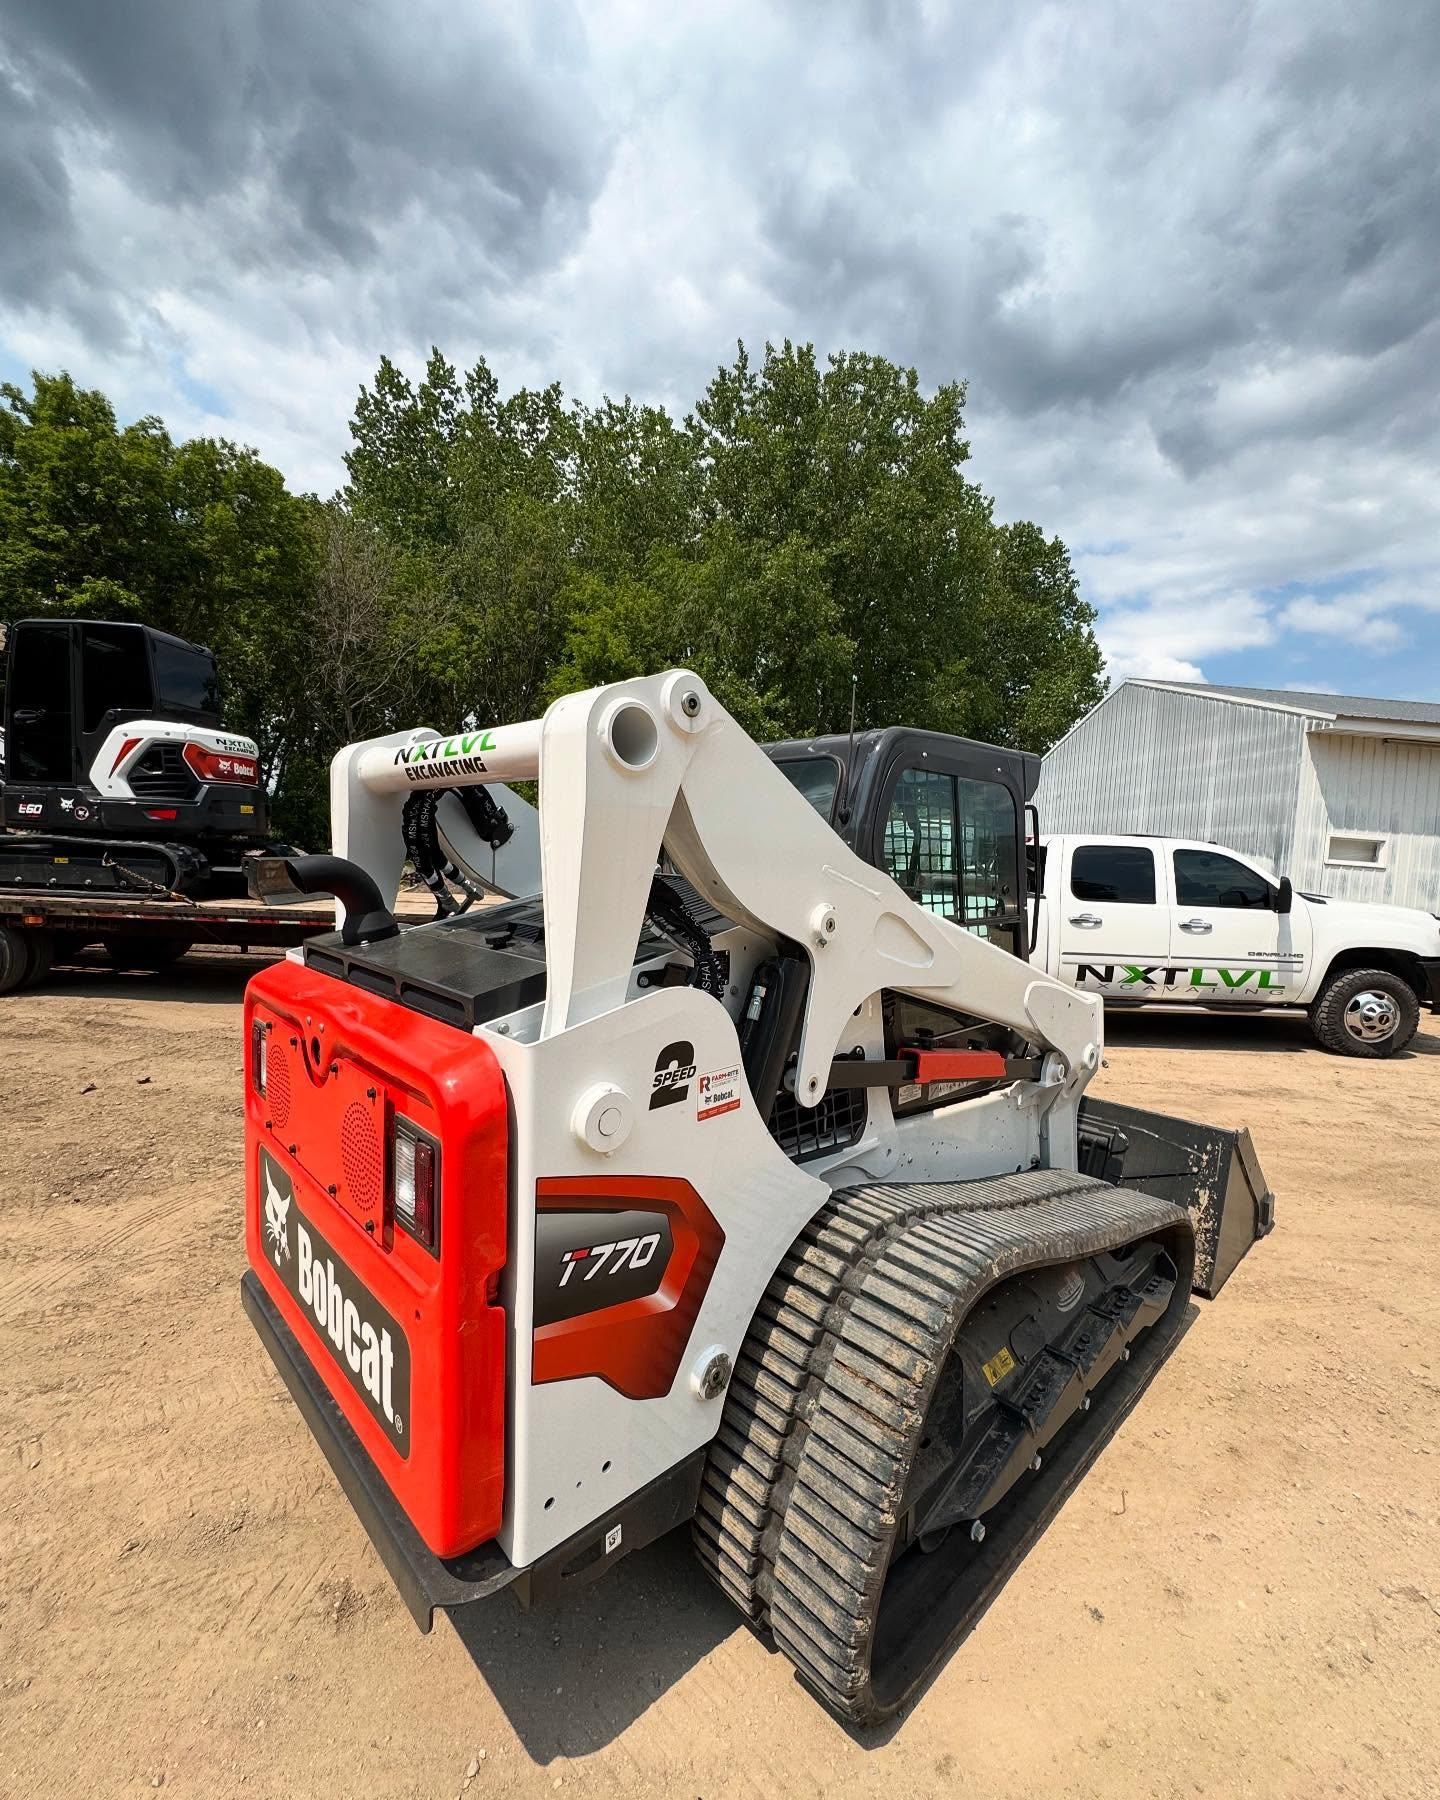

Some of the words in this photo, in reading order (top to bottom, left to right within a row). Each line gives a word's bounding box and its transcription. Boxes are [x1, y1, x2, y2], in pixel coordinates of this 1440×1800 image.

[215, 738, 256, 751] NXTLVL
[393, 732, 497, 765] NXTLVL
[404, 756, 488, 781] EXCAVATING
[1074, 981, 1285, 996] EXCAVATING
[1075, 964, 1286, 990] NXTLVL
[648, 1040, 695, 1111] 2
[652, 1065, 697, 1088] SPEED
[297, 1221, 395, 1424] Bobcat
